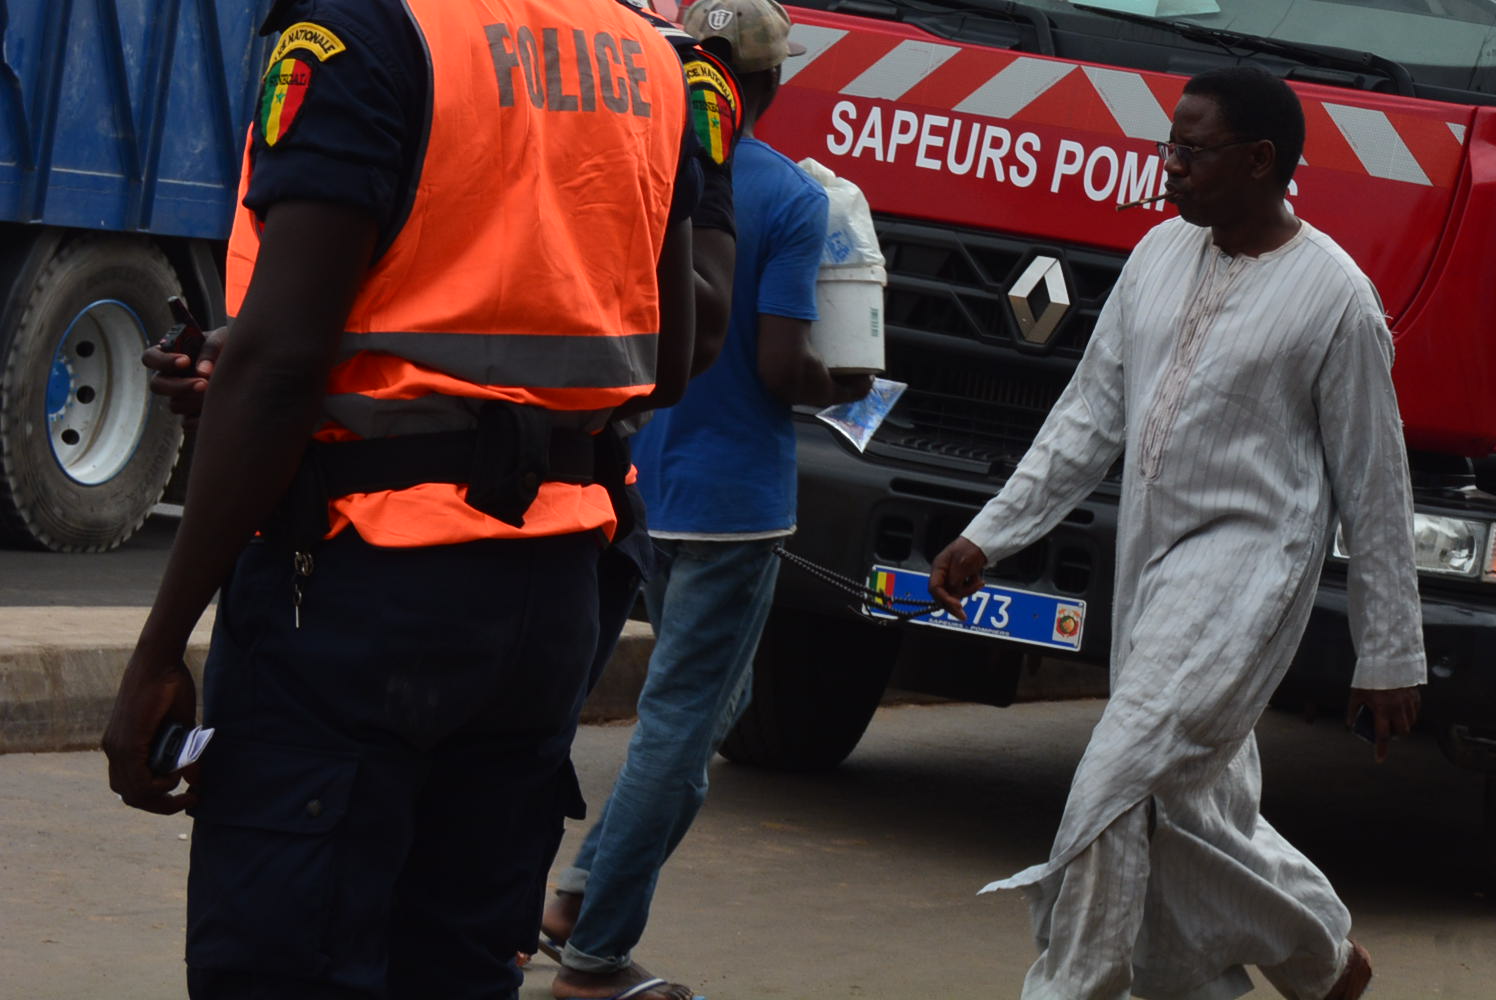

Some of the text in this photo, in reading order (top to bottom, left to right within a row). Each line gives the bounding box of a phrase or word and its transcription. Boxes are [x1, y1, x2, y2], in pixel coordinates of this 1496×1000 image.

[288, 29, 336, 54] NATIONALE
[484, 22, 652, 119] POLICE
[826, 100, 1044, 189] SAPEURS
[928, 617, 964, 630] SAPEURS
[969, 625, 1011, 637] POMPIERS
